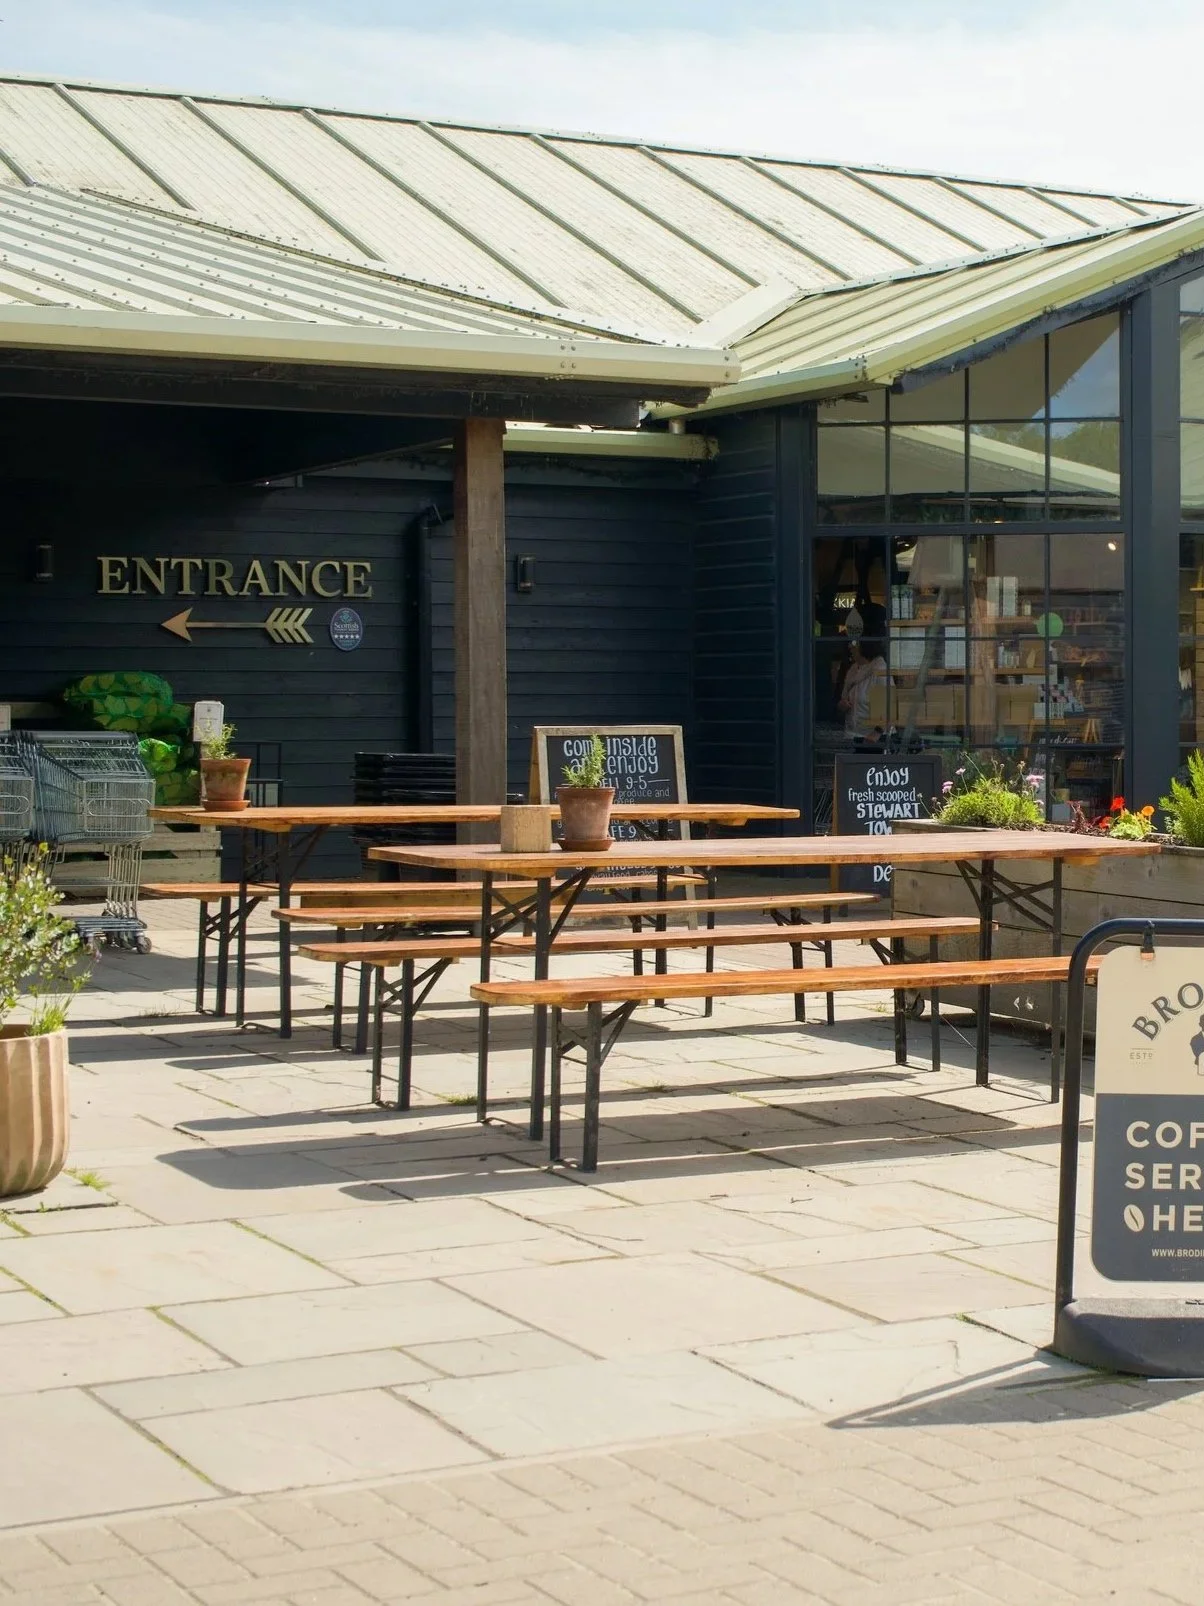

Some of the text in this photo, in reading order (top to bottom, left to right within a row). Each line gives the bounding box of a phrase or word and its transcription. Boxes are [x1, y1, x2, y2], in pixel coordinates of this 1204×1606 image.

[97, 556, 373, 598] ENTRANCE
[563, 735, 657, 757] com inside
[607, 754, 659, 775] enjoy
[625, 774, 648, 790] 9-5
[866, 765, 909, 787] enjoy
[618, 786, 670, 799] produce and
[848, 786, 916, 803] fresh scooped
